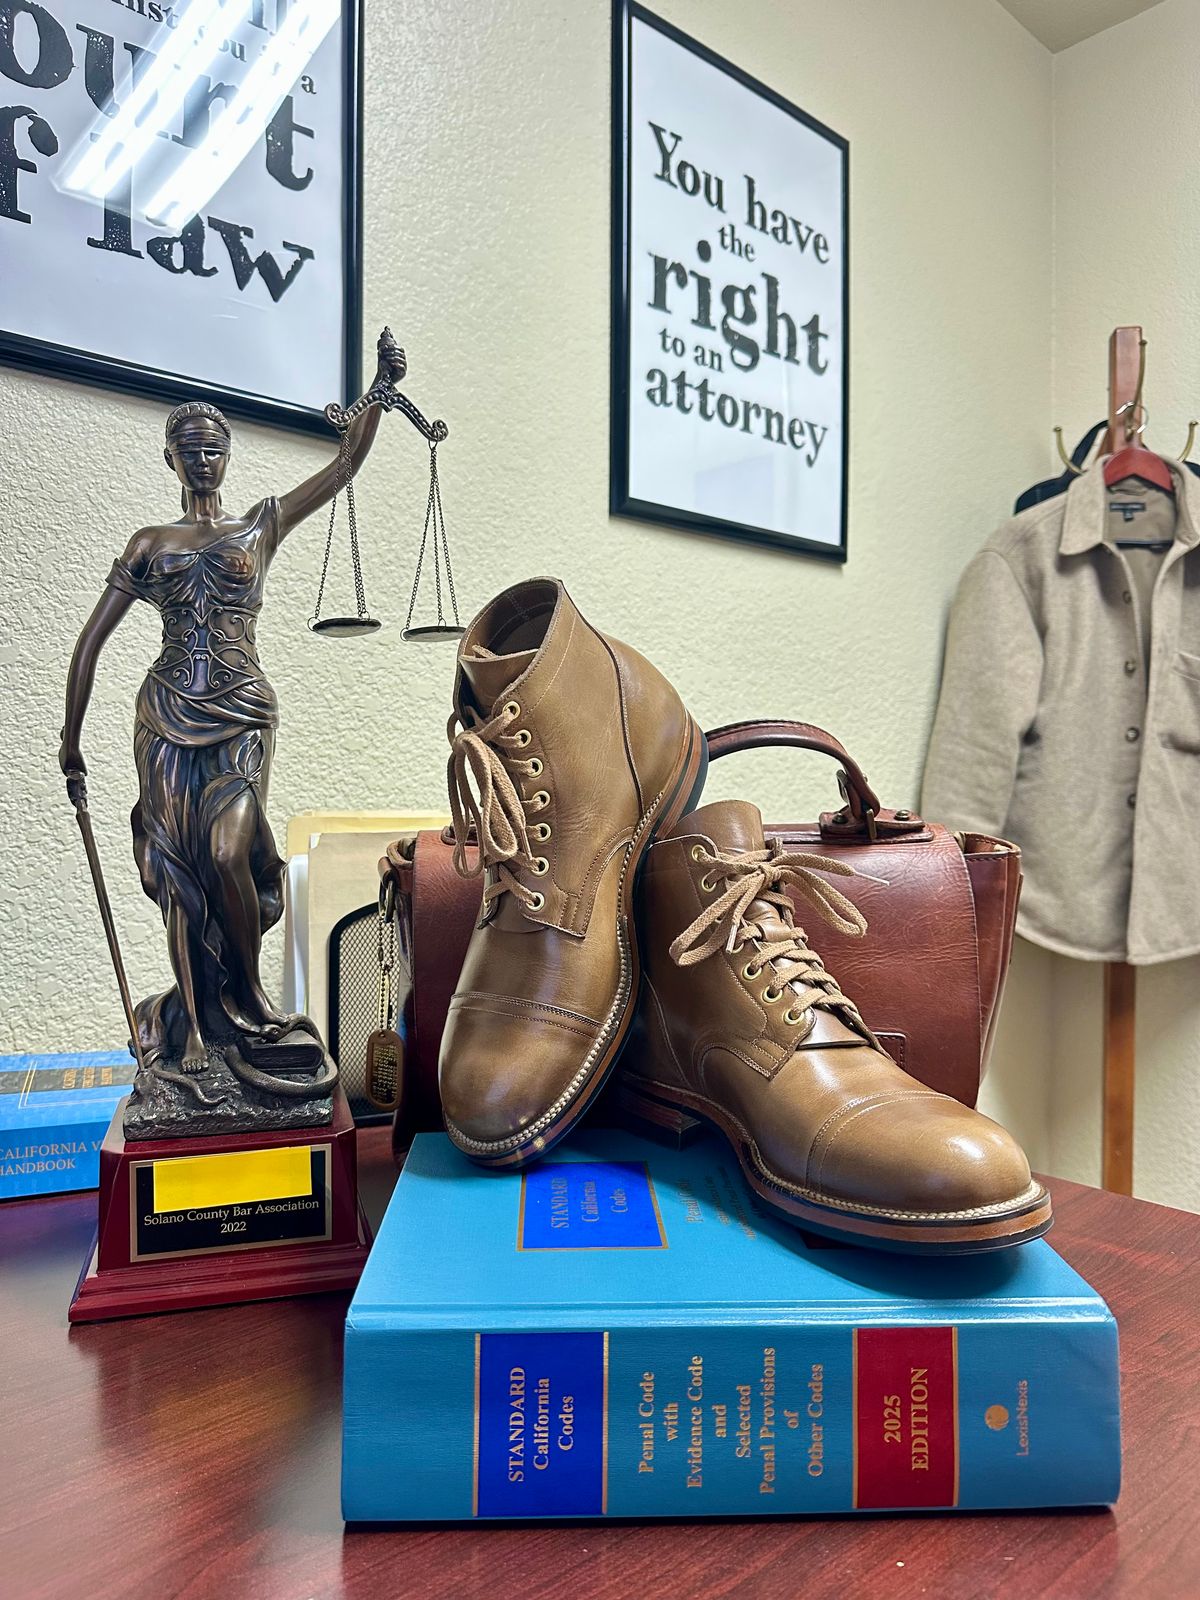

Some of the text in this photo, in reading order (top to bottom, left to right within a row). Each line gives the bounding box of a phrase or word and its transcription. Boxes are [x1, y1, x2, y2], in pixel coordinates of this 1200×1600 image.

[301, 75, 316, 95] a
[87, 132, 315, 302] law
[648, 121, 829, 264] You have
[718, 225, 755, 262] the
[648, 239, 828, 376] right
[659, 327, 725, 373] to an
[645, 367, 828, 467] attorney
[144, 1199, 320, 1226] Solano County Bar Association
[220, 1221, 247, 1234] 2022
[551, 1177, 569, 1229] STANDARD
[508, 1366, 525, 1482] STANDARD
[533, 1377, 550, 1470] California
[558, 1395, 574, 1451] Codes
[639, 1371, 655, 1474] Penal Code
[664, 1401, 679, 1442] with
[687, 1355, 704, 1488] Evidence Code
[712, 1403, 727, 1438] and
[736, 1384, 751, 1458] Selected
[760, 1347, 776, 1494] Penal Provisions
[783, 1409, 799, 1429] of
[807, 1363, 824, 1477] Other Codes
[884, 1394, 901, 1443] 2025
[910, 1367, 929, 1471] EDITION
[1016, 1379, 1029, 1456] LexisNexis
